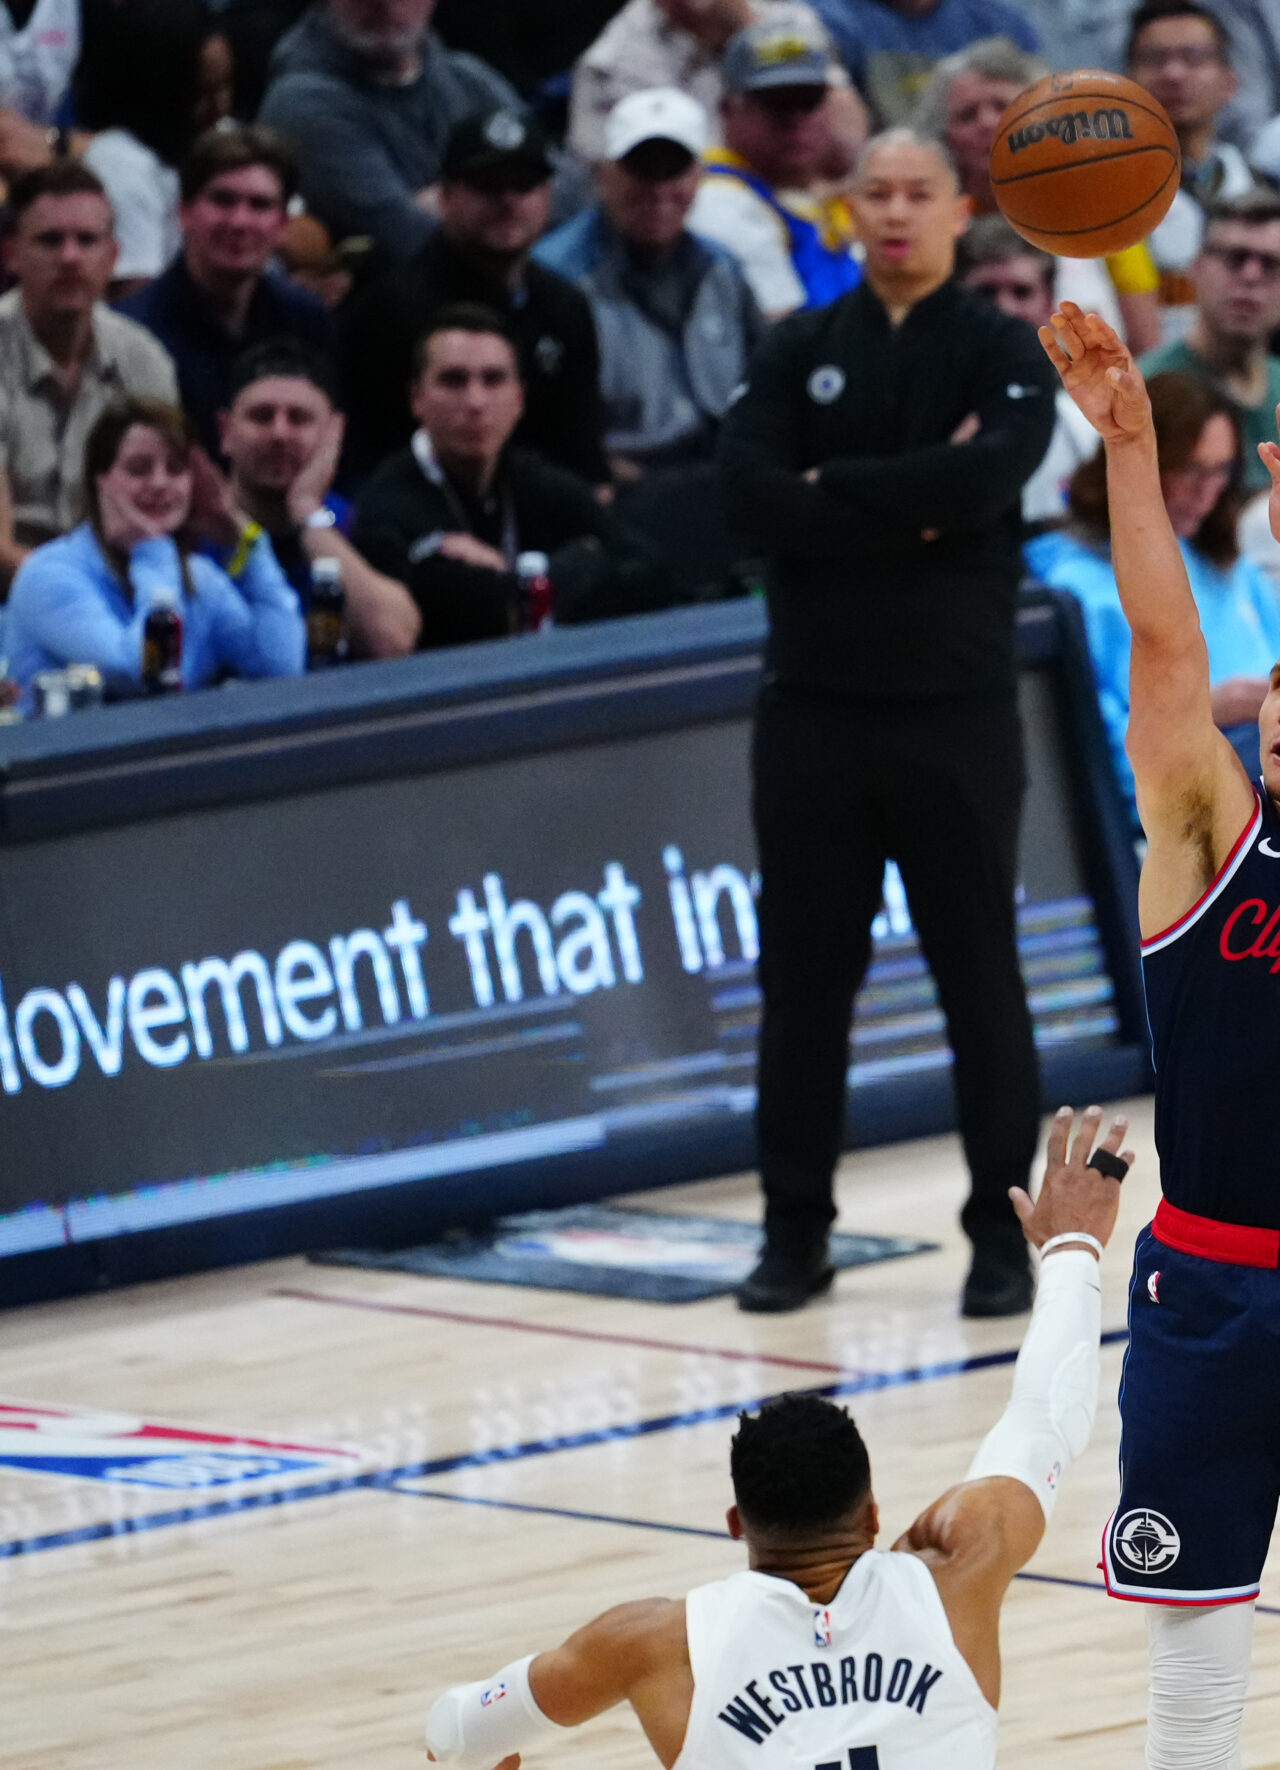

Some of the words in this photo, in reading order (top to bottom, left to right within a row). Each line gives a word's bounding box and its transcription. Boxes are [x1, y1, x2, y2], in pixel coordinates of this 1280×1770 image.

[1007, 108, 1134, 154] Wilson
[449, 860, 645, 1008] that
[717, 1653, 943, 1745] WESTBROOK
